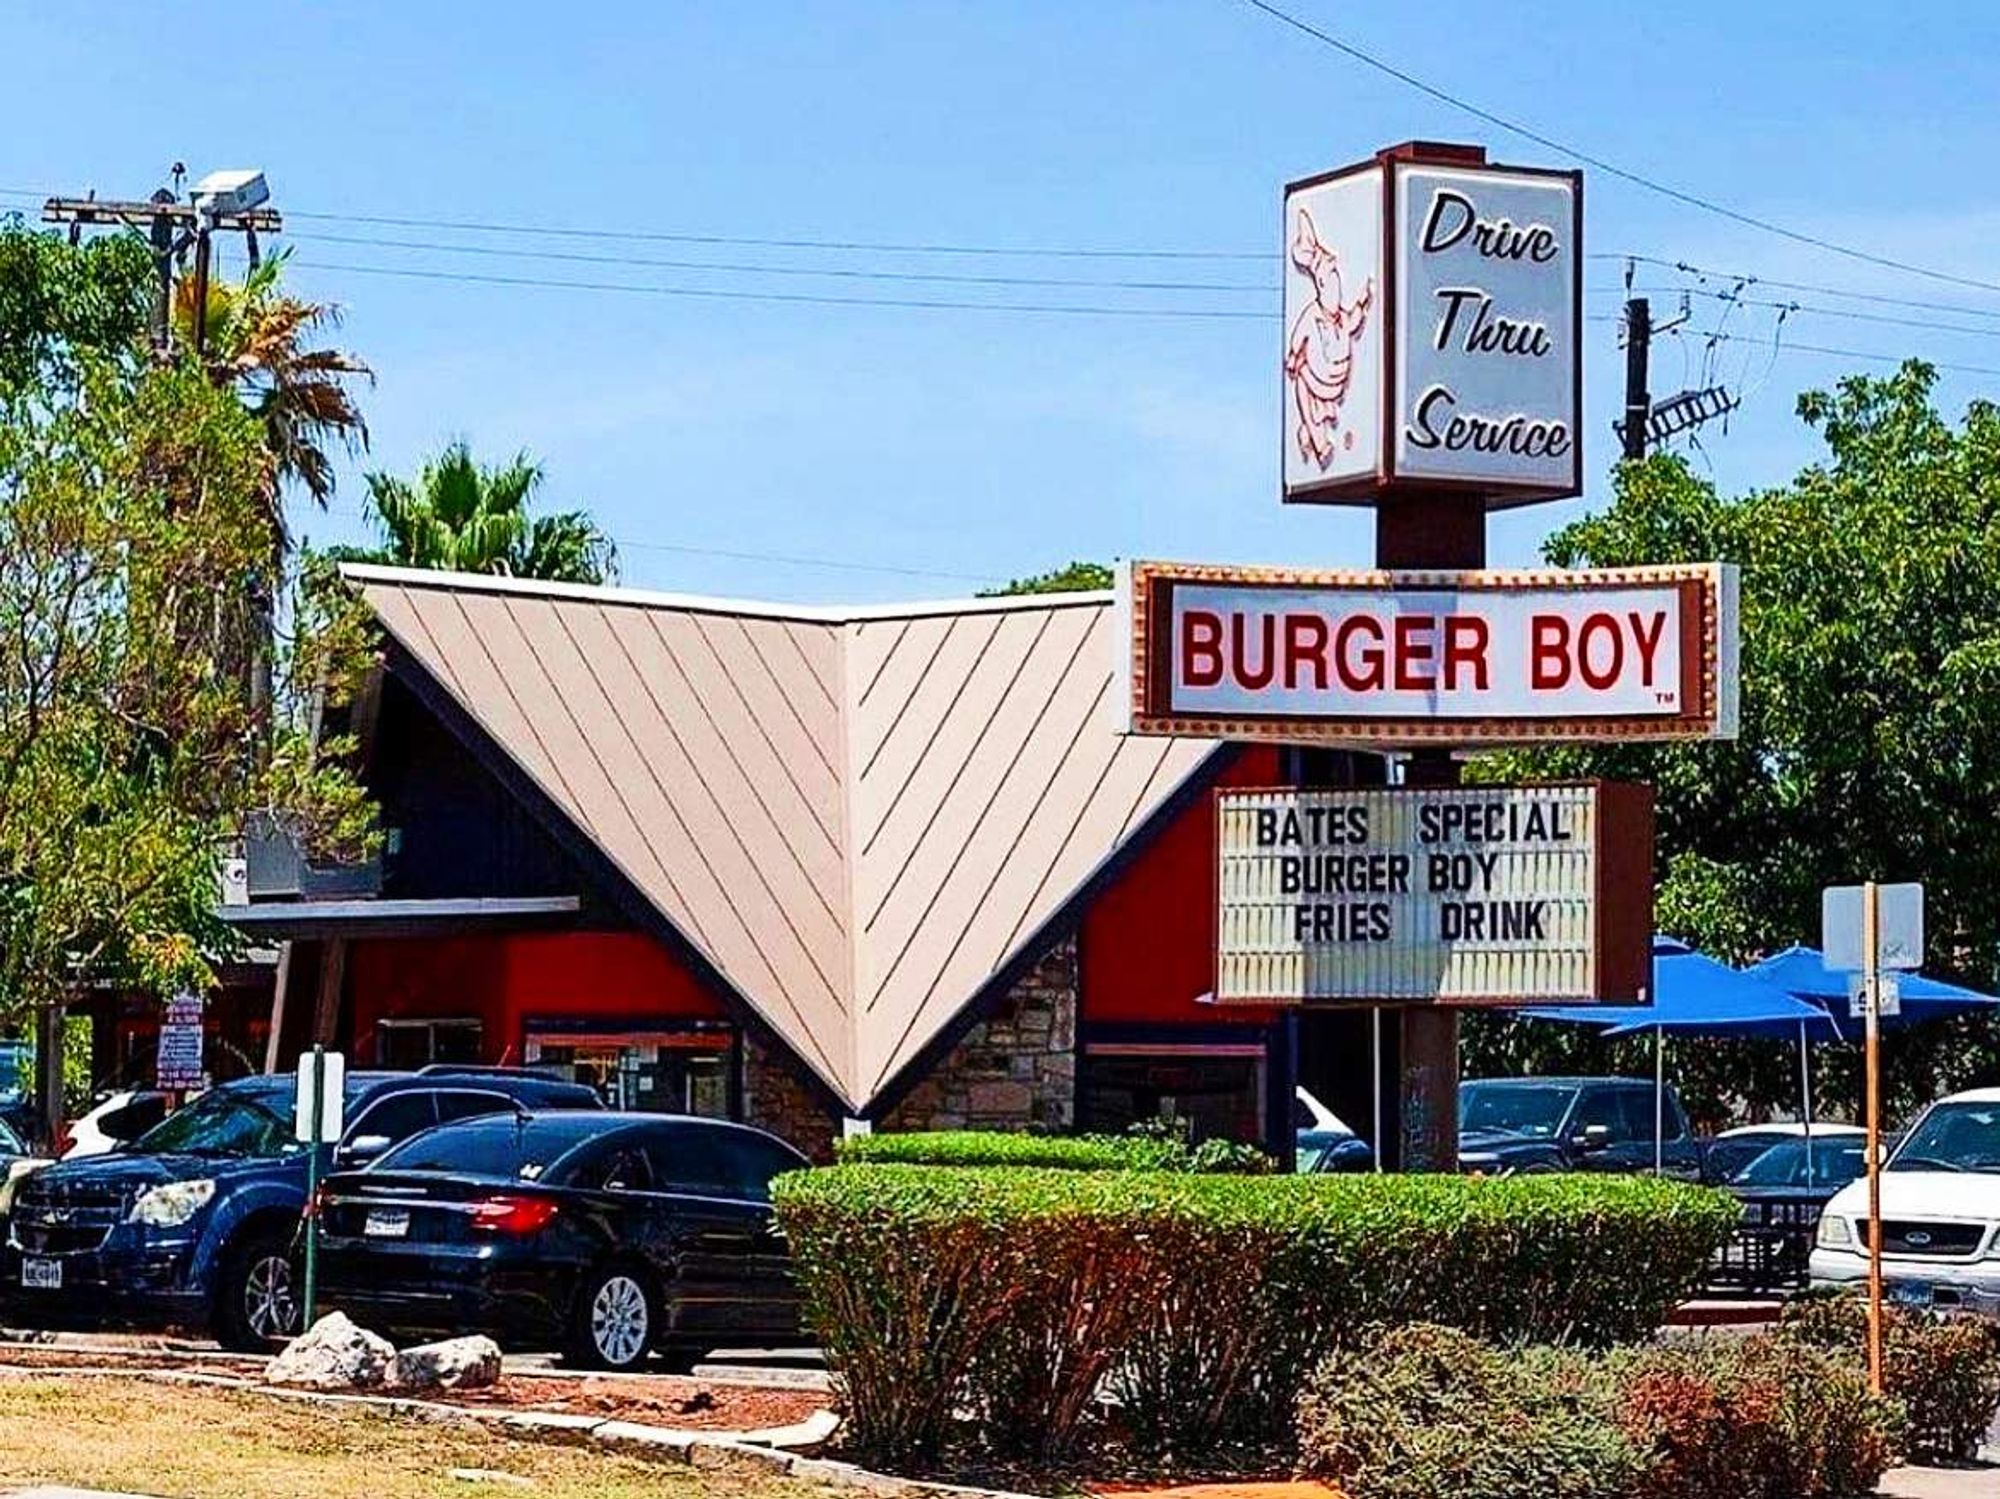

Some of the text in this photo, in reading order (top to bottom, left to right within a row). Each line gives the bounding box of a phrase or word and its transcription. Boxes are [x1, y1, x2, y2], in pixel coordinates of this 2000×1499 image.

[1423, 192, 1559, 262] Drive
[1437, 290, 1551, 357] Thru
[1406, 387, 1571, 457] Service
[1182, 611, 1667, 692] BURGER BOY
[1257, 802, 1571, 846] BATES SPECIAL
[1281, 852, 1499, 894] BURGER BOY
[1294, 900, 1545, 942] FRIES DRINK
